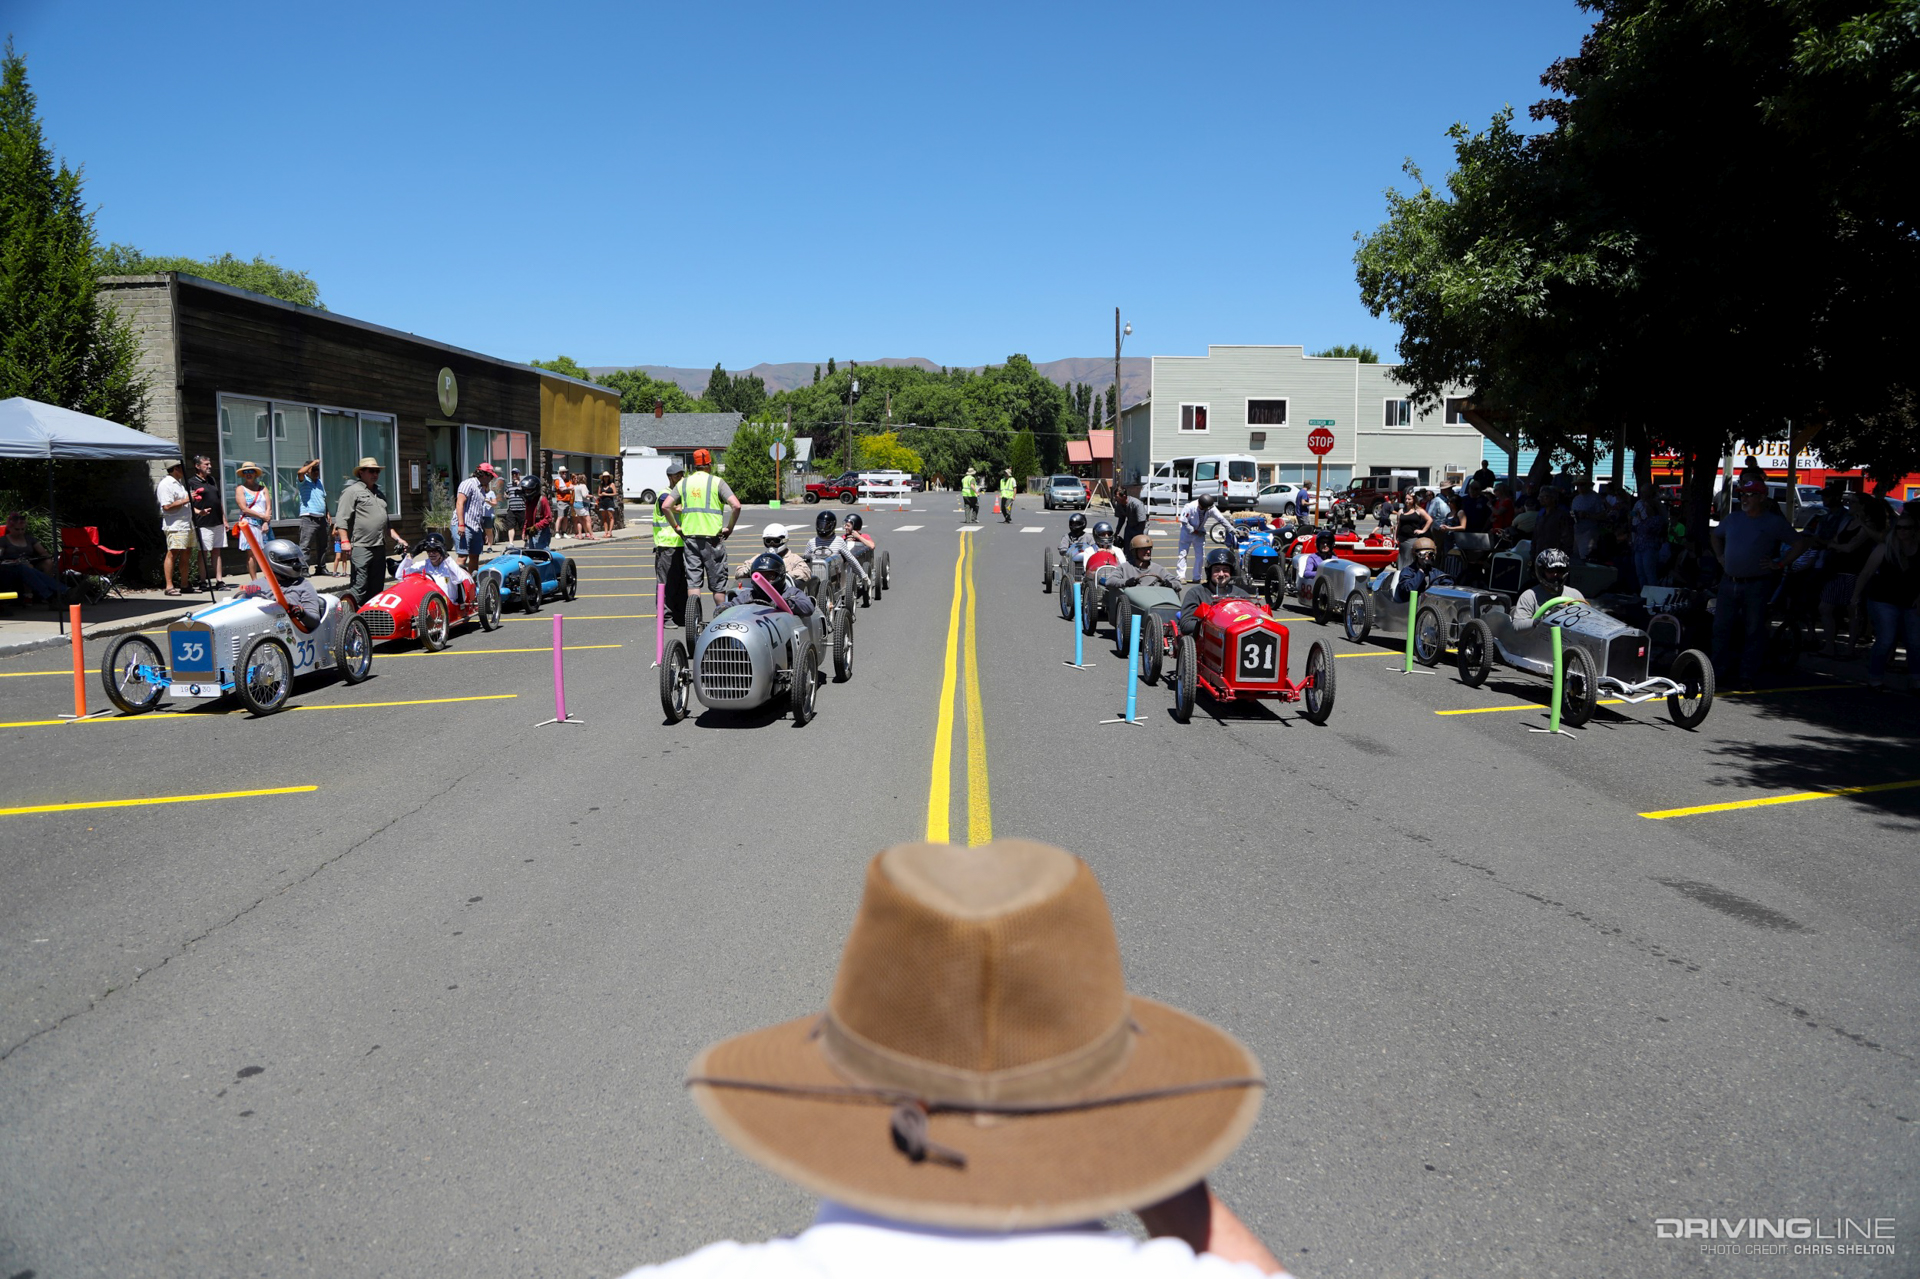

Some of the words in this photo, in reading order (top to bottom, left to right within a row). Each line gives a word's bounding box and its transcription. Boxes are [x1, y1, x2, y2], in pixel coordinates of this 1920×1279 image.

[1309, 436, 1333, 447] STOP
[1772, 458, 1818, 468] BAERY
[1300, 583, 1314, 600] 88
[365, 593, 402, 609] 40
[178, 642, 204, 662] 35
[293, 639, 315, 669] 35
[1244, 644, 1272, 669] 31
